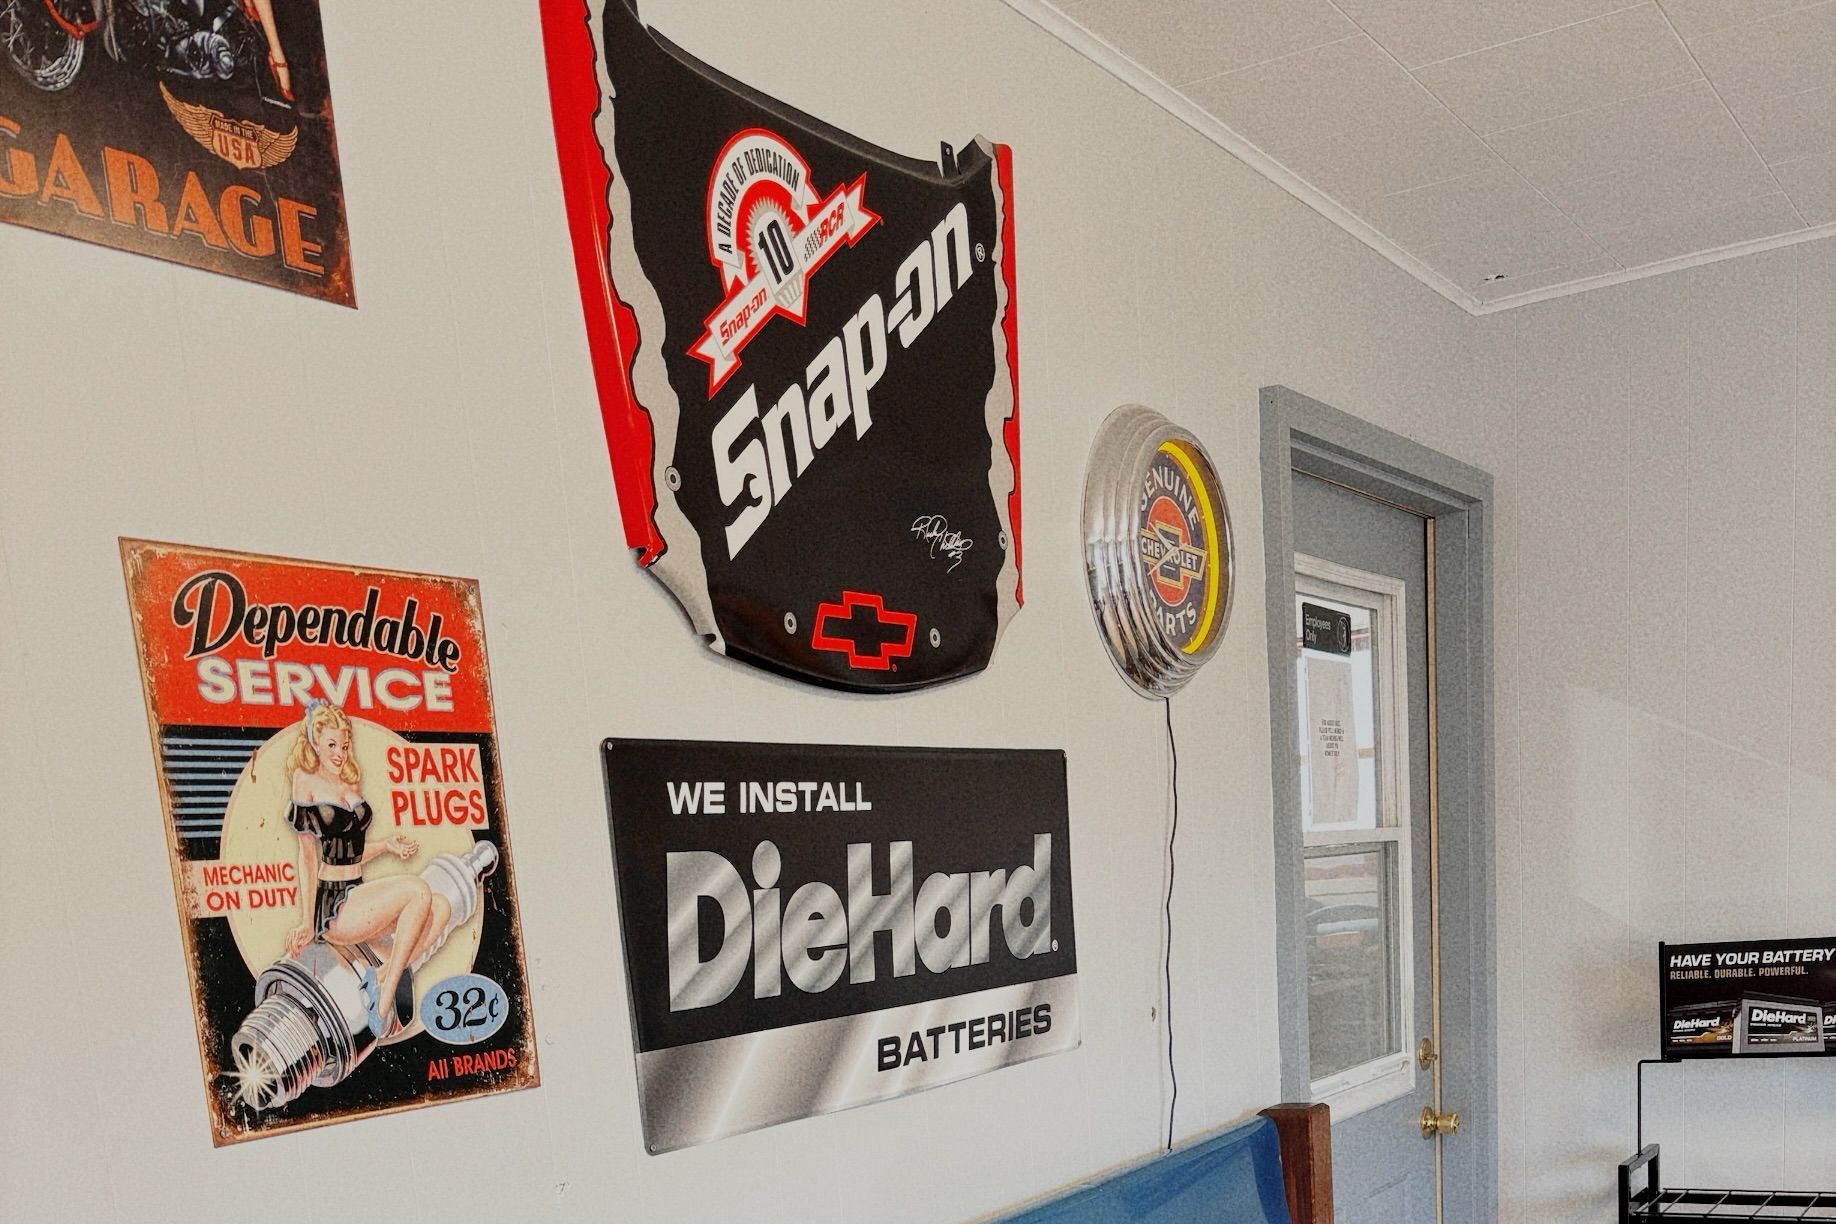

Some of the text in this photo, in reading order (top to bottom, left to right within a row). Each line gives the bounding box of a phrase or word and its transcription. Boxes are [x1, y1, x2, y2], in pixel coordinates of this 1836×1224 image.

[218, 133, 256, 166] USA
[716, 147, 800, 254] A DECADE OF DEDICATION
[758, 219, 795, 285] 10
[720, 287, 769, 346] Snap-on
[711, 202, 973, 561] Snap-on
[171, 570, 460, 675] Dependable
[1305, 613, 1331, 631] Employees
[1305, 629, 1317, 645] Only
[197, 656, 455, 713] SERVICE
[386, 747, 480, 784] SPARK
[391, 789, 486, 827] PLUGS
[667, 781, 873, 815] WE INSTALL
[202, 863, 296, 887] MECHANIC
[206, 887, 298, 911] ON DUTY
[666, 832, 1052, 1013] DieHard
[1669, 948, 1836, 968] HAVE YOUR BATTERY
[1669, 965, 1809, 980] RELIABLE. DURABLE. POWERFUL.
[1673, 1016, 1721, 1030] DieHard
[1751, 1008, 1807, 1025] DieHard
[877, 1003, 1052, 1073] BATTERIES
[453, 1049, 517, 1076] BRANDS
